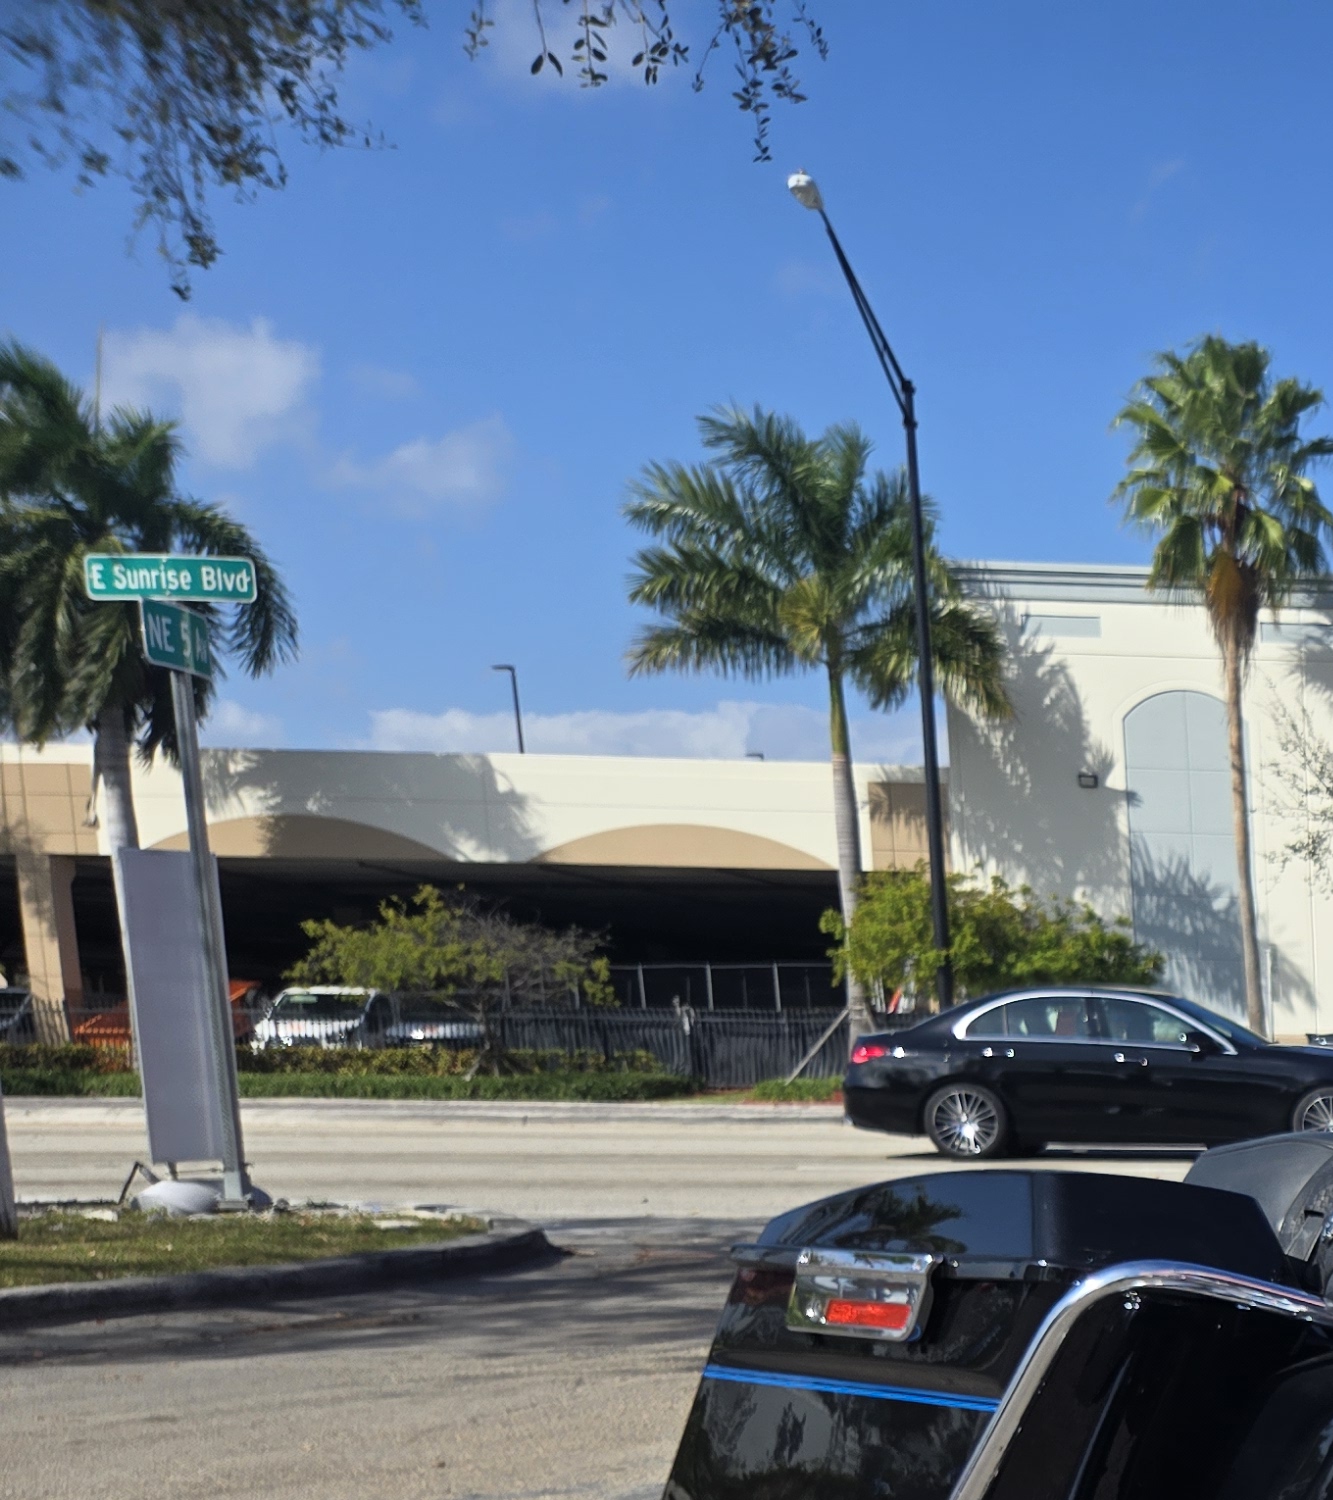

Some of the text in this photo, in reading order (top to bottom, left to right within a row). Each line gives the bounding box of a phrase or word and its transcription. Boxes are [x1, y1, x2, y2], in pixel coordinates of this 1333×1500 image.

[91, 562, 250, 593] E Sunrise Blvd
[147, 613, 175, 653] NE
